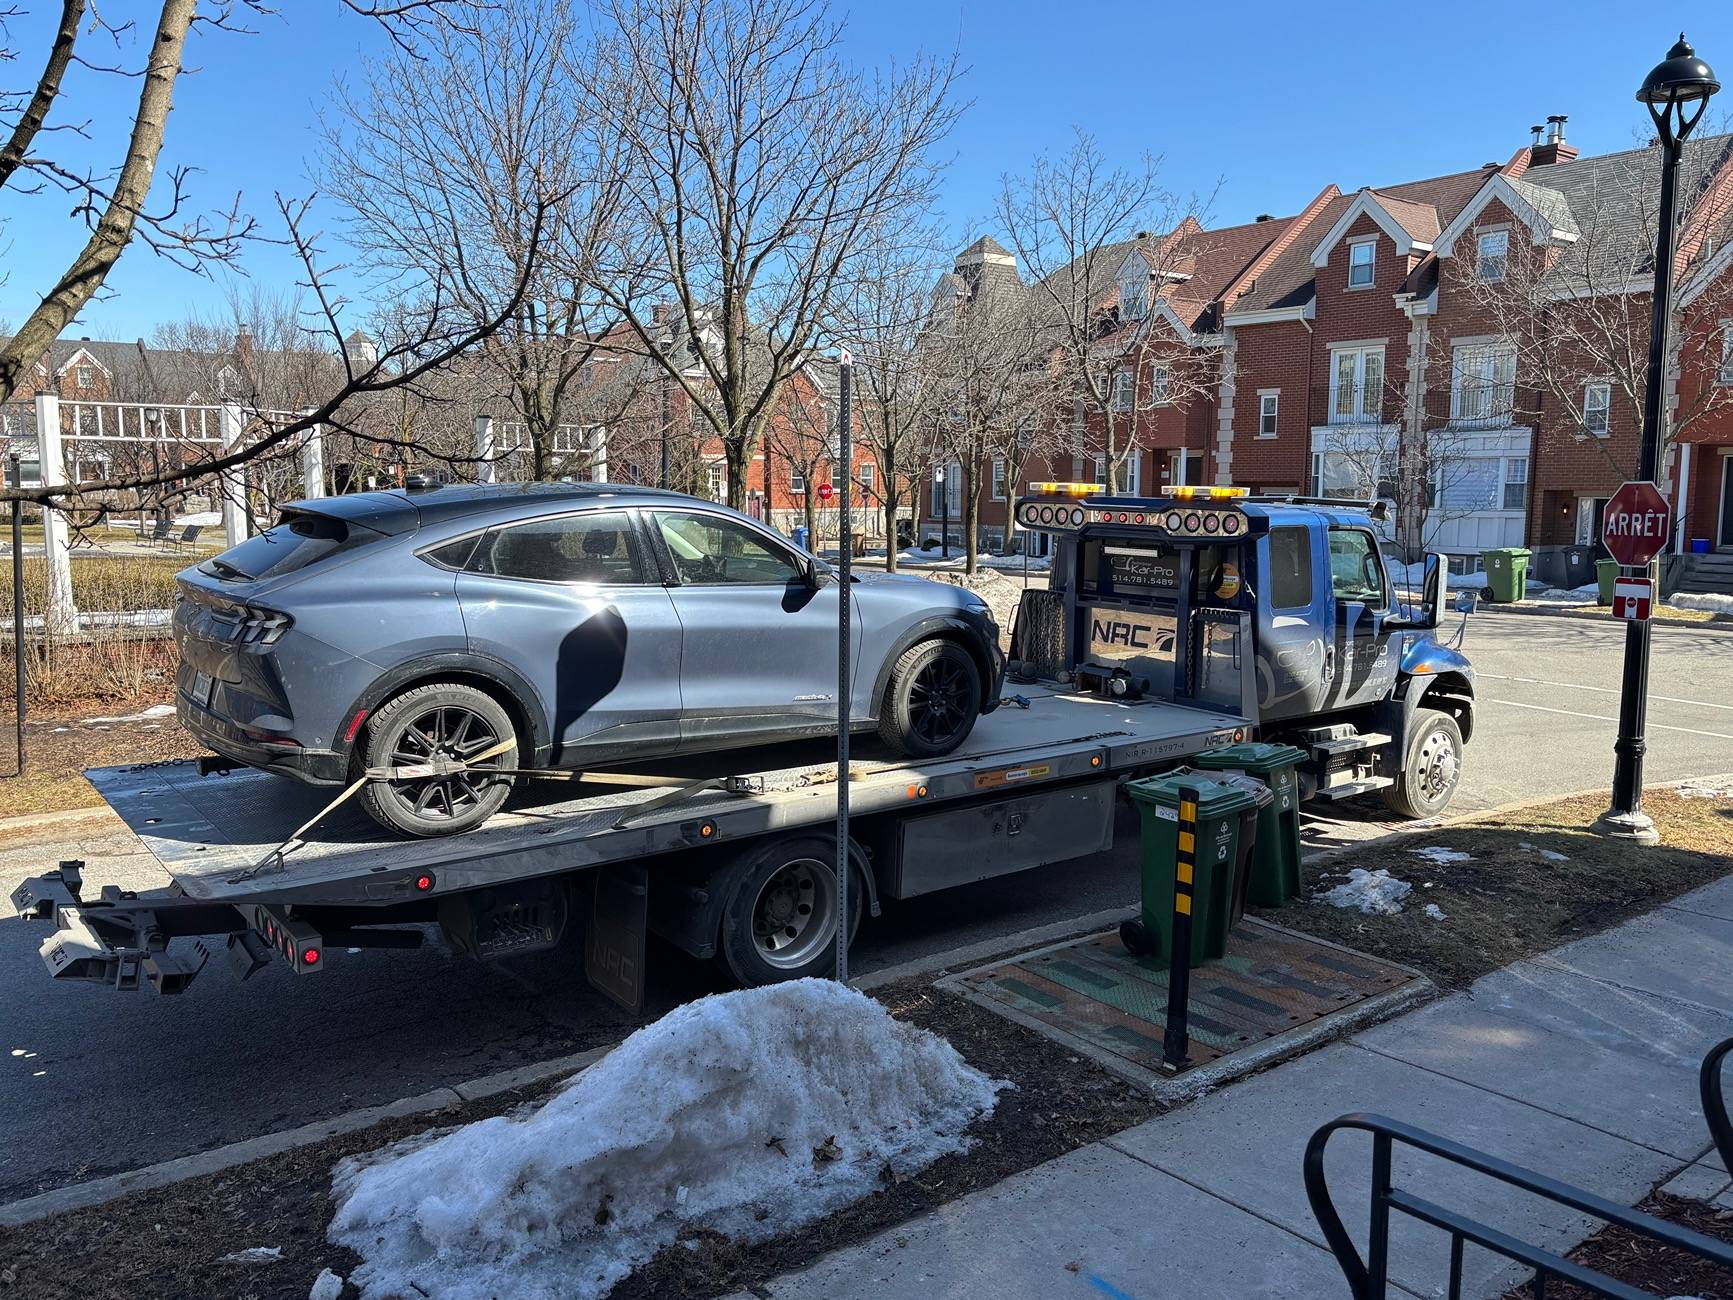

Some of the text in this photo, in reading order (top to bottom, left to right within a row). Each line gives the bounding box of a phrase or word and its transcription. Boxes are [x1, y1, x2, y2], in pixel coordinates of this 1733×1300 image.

[1606, 509, 1666, 537] ARRÊT
[1112, 574, 1174, 586] 514.781.5489
[1131, 564, 1174, 577] Kar-Pro
[1091, 619, 1152, 649] NRC
[1204, 733, 1226, 747] NRC
[592, 942, 635, 988] NRC
